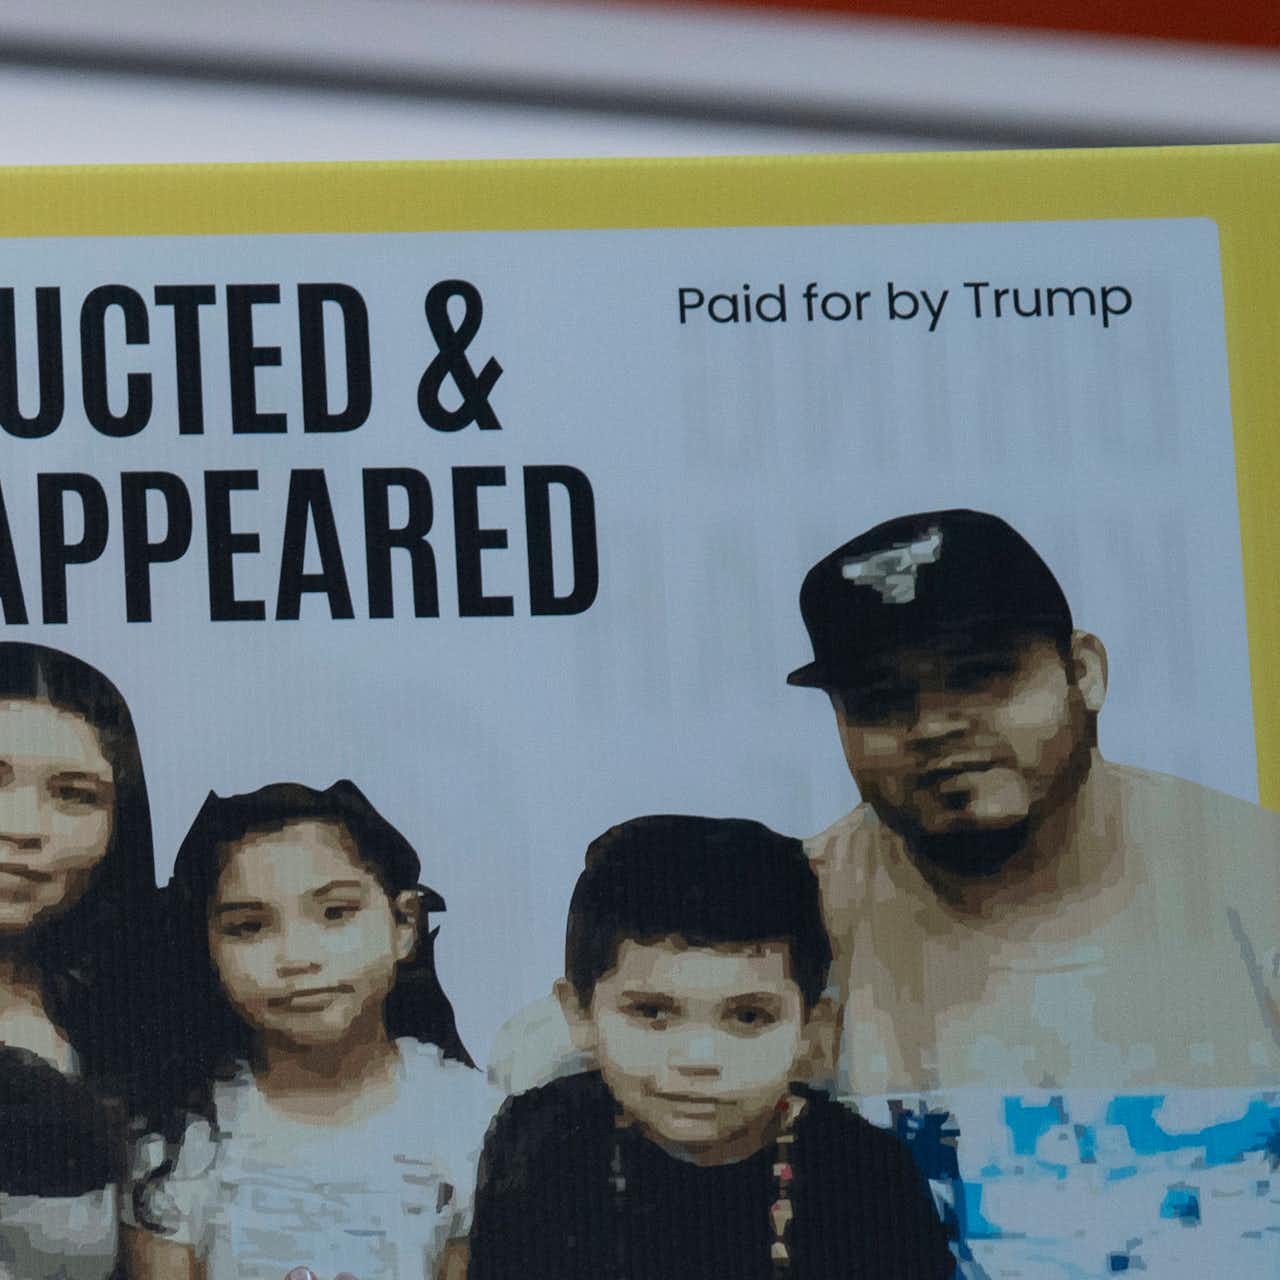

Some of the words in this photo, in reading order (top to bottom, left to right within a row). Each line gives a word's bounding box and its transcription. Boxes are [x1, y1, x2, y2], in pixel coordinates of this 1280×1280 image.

[416, 278, 504, 433] &
[678, 284, 788, 324] Paid
[803, 282, 872, 322] for
[887, 281, 950, 333] by
[963, 281, 1133, 328] Trump
